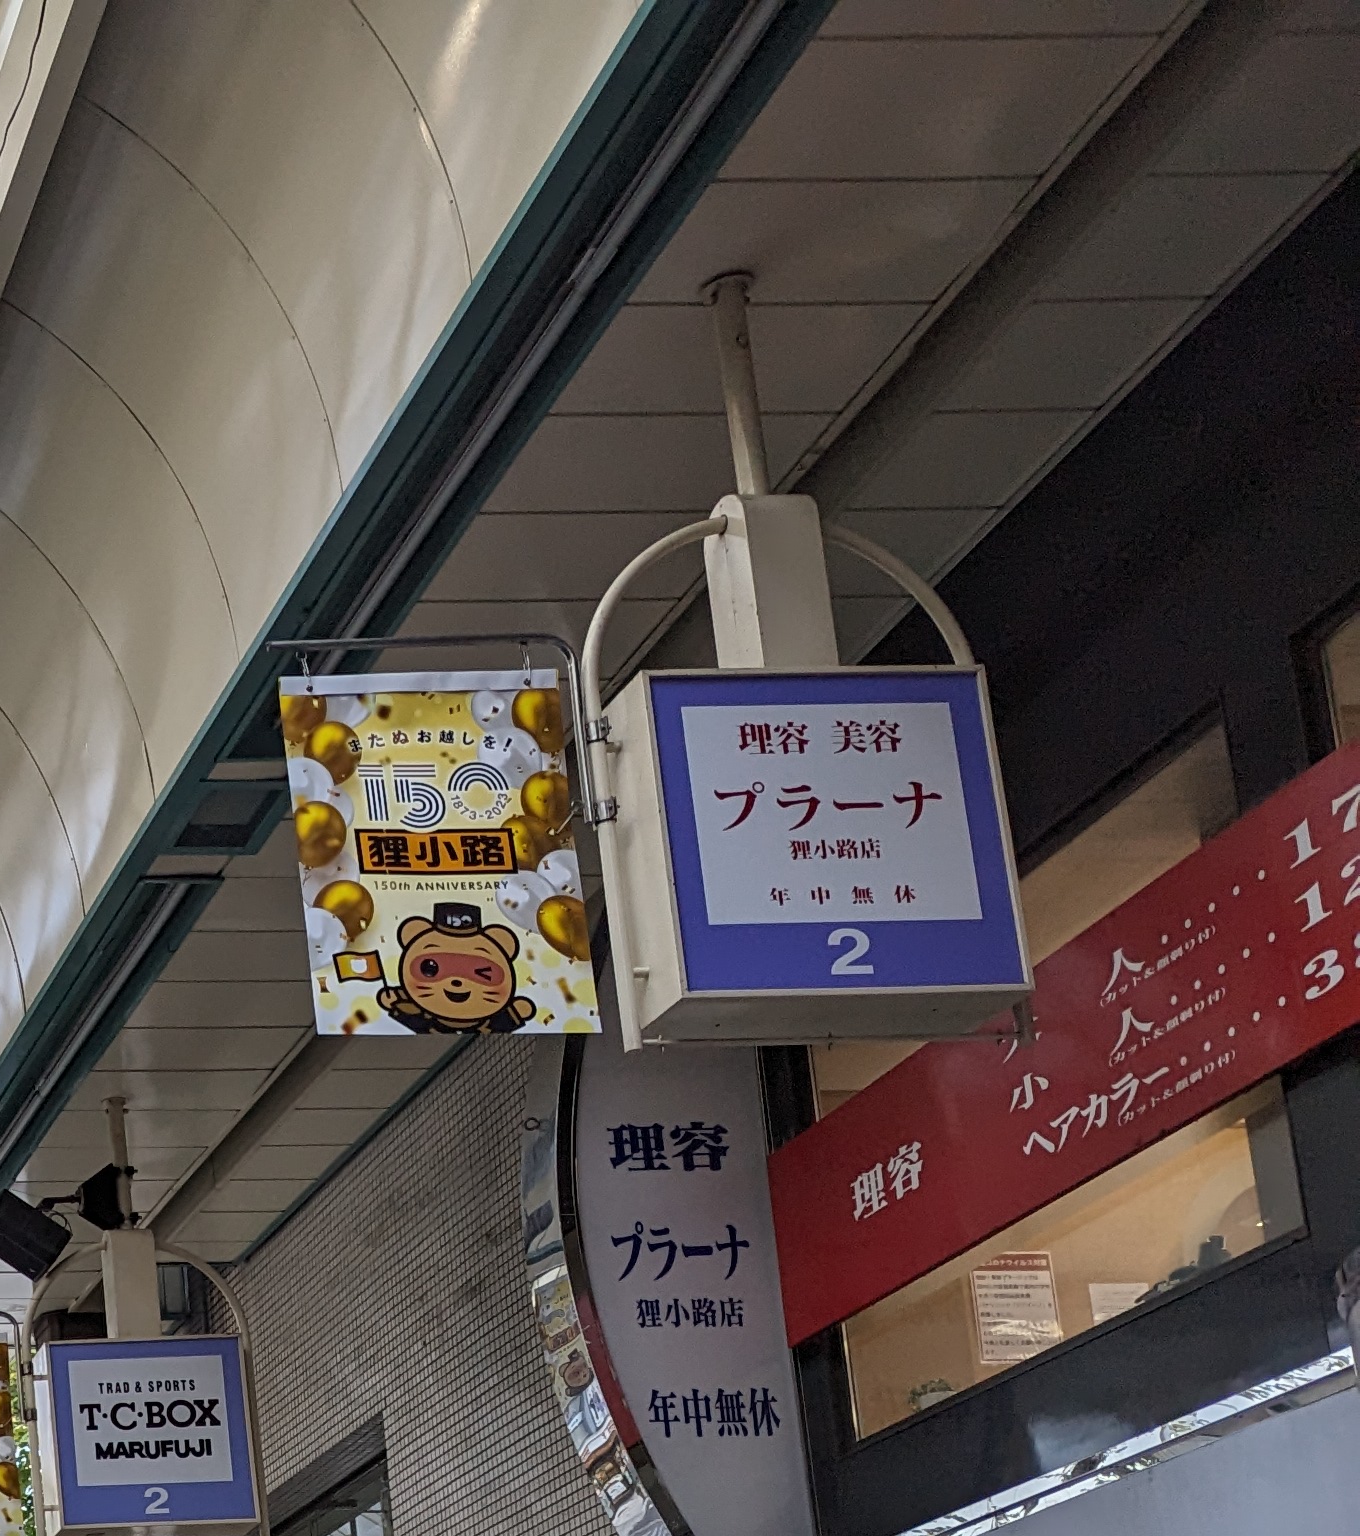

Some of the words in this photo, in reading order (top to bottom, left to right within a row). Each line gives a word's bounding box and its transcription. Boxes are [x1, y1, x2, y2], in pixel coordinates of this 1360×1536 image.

[737, 721, 809, 758] 理容
[832, 719, 903, 756] 美容
[450, 791, 511, 821] 1873-2023
[713, 780, 944, 832] プラーナ
[368, 833, 508, 869] 狸小路
[789, 837, 882, 862] 狸小路店
[373, 879, 411, 892] 150th
[416, 879, 510, 893] ANNIVERSARY
[769, 885, 917, 906] 年中無休
[826, 928, 875, 977] 2
[1009, 1071, 1050, 1114] 小
[1021, 1065, 1170, 1158] ヘアカラー
[606, 1121, 730, 1173] 理容
[849, 1139, 925, 1222] 理容
[610, 1220, 751, 1283] プラーナ
[636, 1296, 745, 1330] 狸小路店
[97, 1381, 132, 1395] TRAD
[133, 1380, 144, 1393] &
[147, 1378, 197, 1393] SPORTS
[647, 1386, 782, 1441] 年中無休
[94, 1438, 213, 1461] MARUFUJI
[143, 1486, 171, 1515] 2
